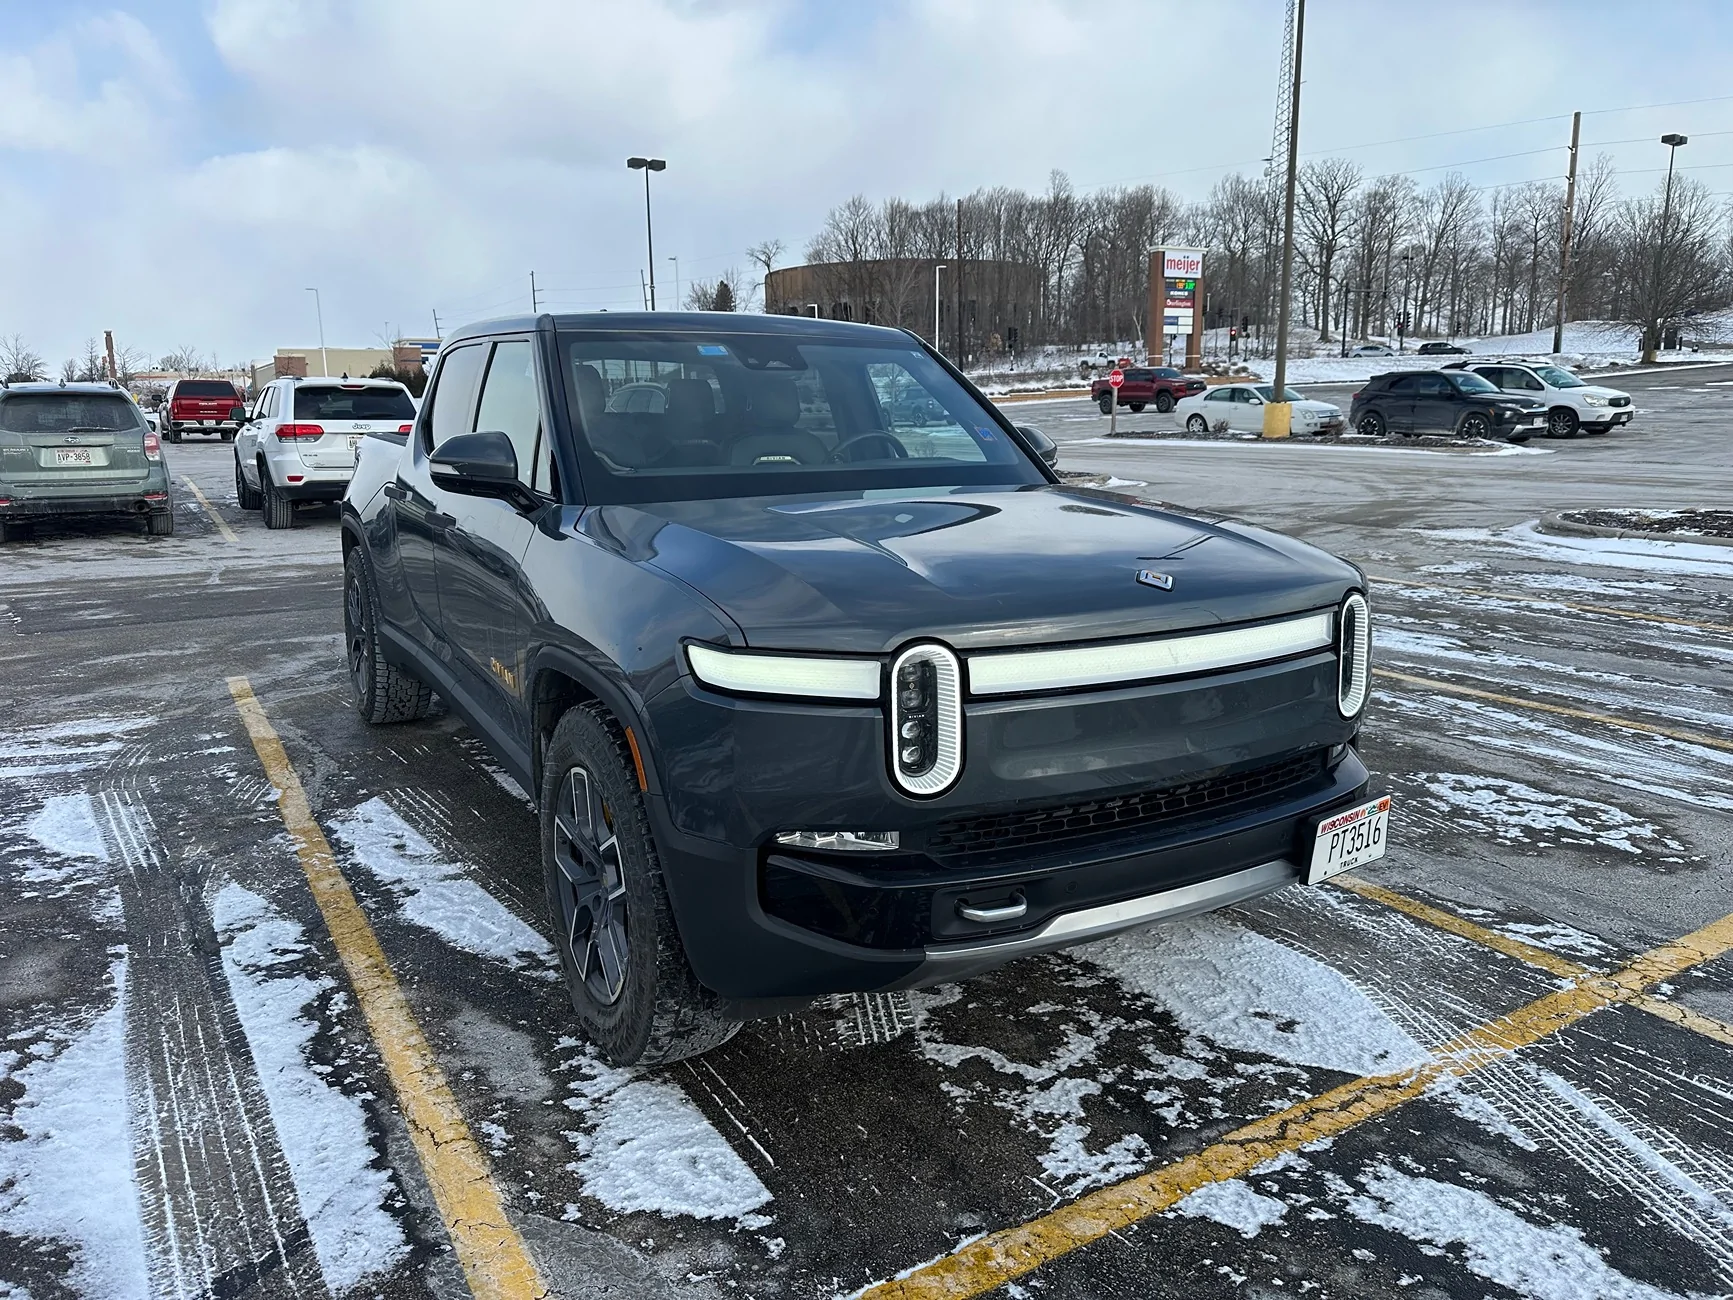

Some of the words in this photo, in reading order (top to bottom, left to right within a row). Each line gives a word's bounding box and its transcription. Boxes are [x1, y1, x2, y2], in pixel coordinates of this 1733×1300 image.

[1166, 255, 1201, 274] meijer
[1110, 375, 1124, 383] STOP
[1320, 809, 1361, 834] WISCONSIN
[1328, 816, 1382, 864] PT3516
[1340, 857, 1359, 869] TRUCK
